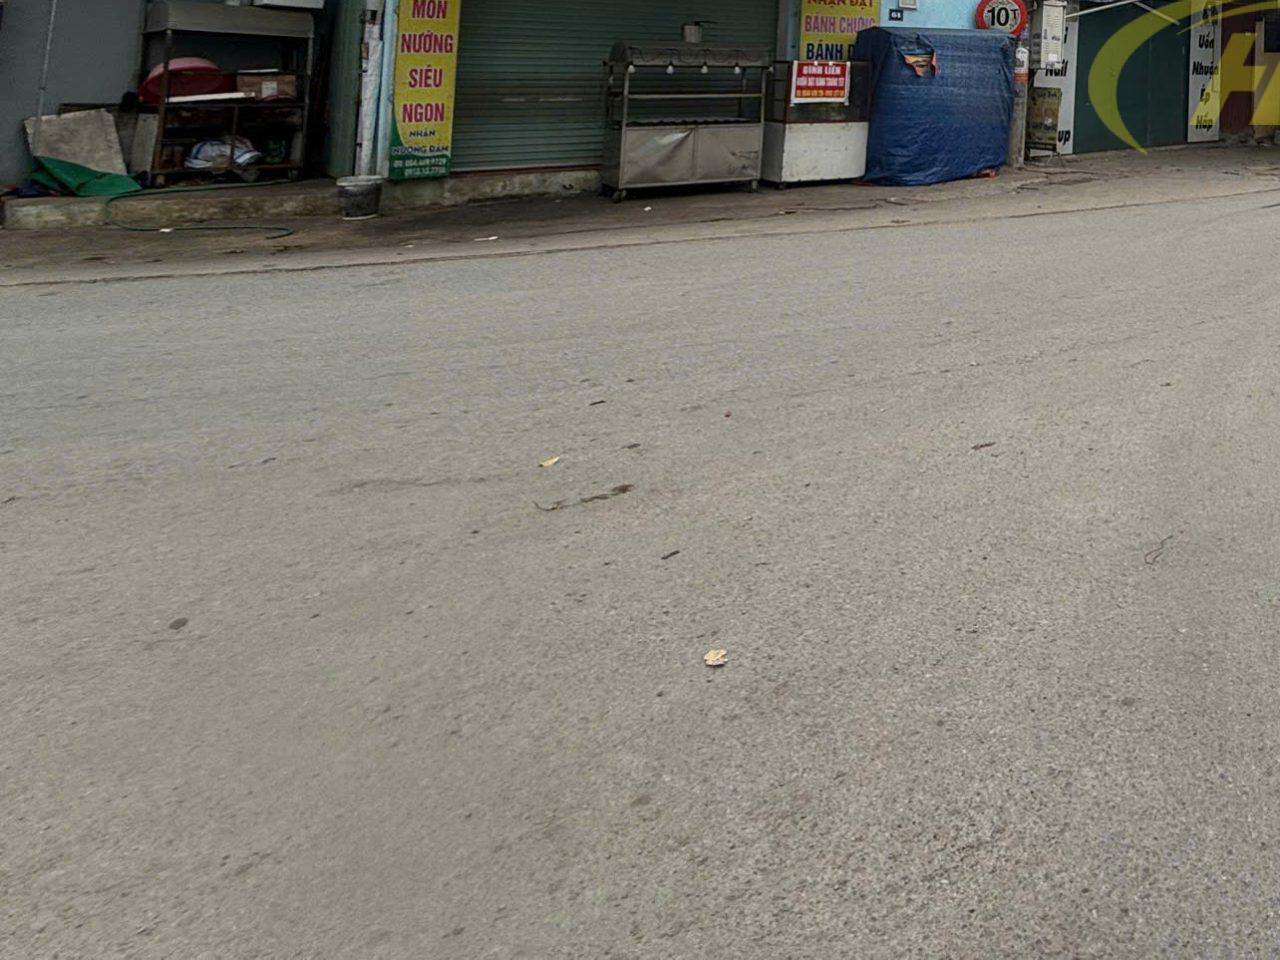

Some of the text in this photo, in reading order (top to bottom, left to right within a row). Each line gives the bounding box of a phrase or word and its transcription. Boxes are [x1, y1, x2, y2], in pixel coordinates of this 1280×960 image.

[804, 12, 836, 33] BÁNH
[400, 29, 454, 54] NƯỚNG
[806, 40, 843, 60] BÁNH
[408, 64, 443, 88] SIÊU
[402, 102, 445, 124] NGON
